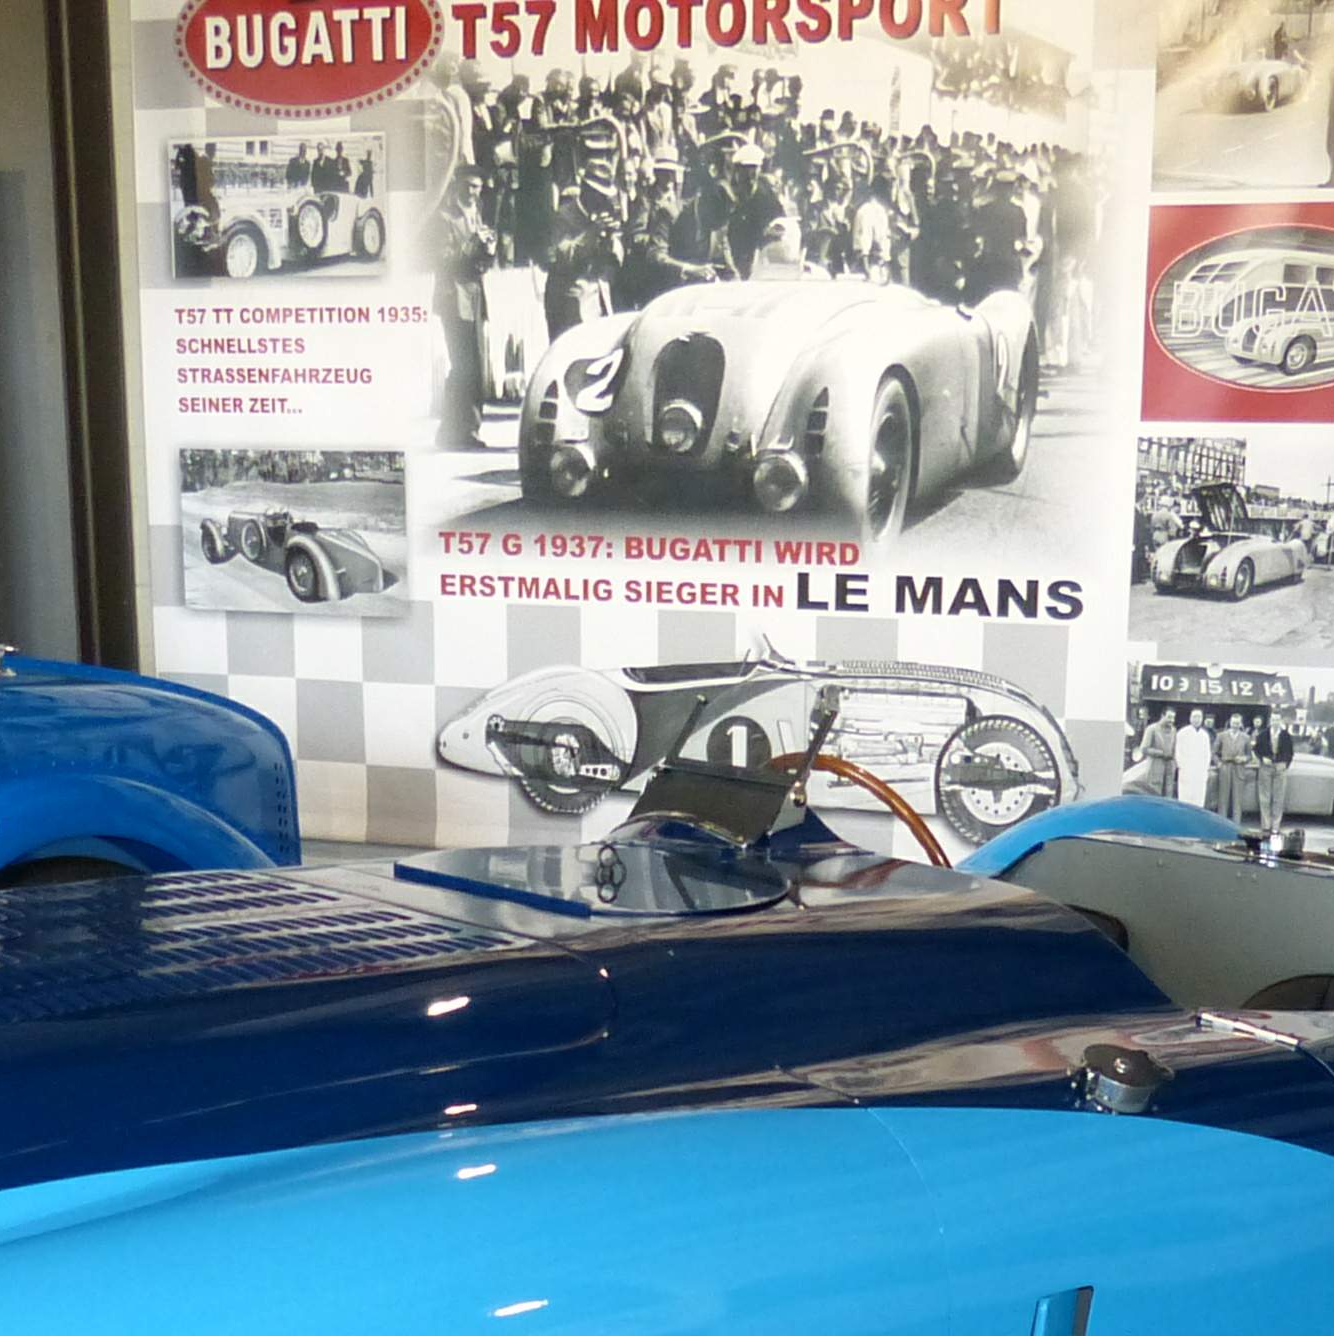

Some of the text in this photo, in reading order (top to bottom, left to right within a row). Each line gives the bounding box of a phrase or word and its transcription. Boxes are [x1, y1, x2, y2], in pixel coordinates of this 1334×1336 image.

[205, 5, 407, 70] BUGATTI
[452, 0, 556, 60] T57
[174, 306, 429, 325] T57 TT COMPETITION 1935:
[176, 337, 306, 354] SCHNELLSTES
[177, 367, 373, 384] STRASSENFAHRZEUG
[576, 347, 624, 412] 2
[178, 397, 303, 414] SEINER ZEIT...
[439, 531, 860, 566] T57 G 1937: BUGATTI WIRD
[440, 573, 784, 608] ERSTMALIG SIEGER IN
[797, 571, 1085, 622] LE MANS
[1151, 675, 1174, 691] 10
[1200, 679, 1223, 696] 15
[1231, 681, 1254, 696] 12
[1263, 682, 1286, 697] 14
[726, 725, 747, 768] 1
